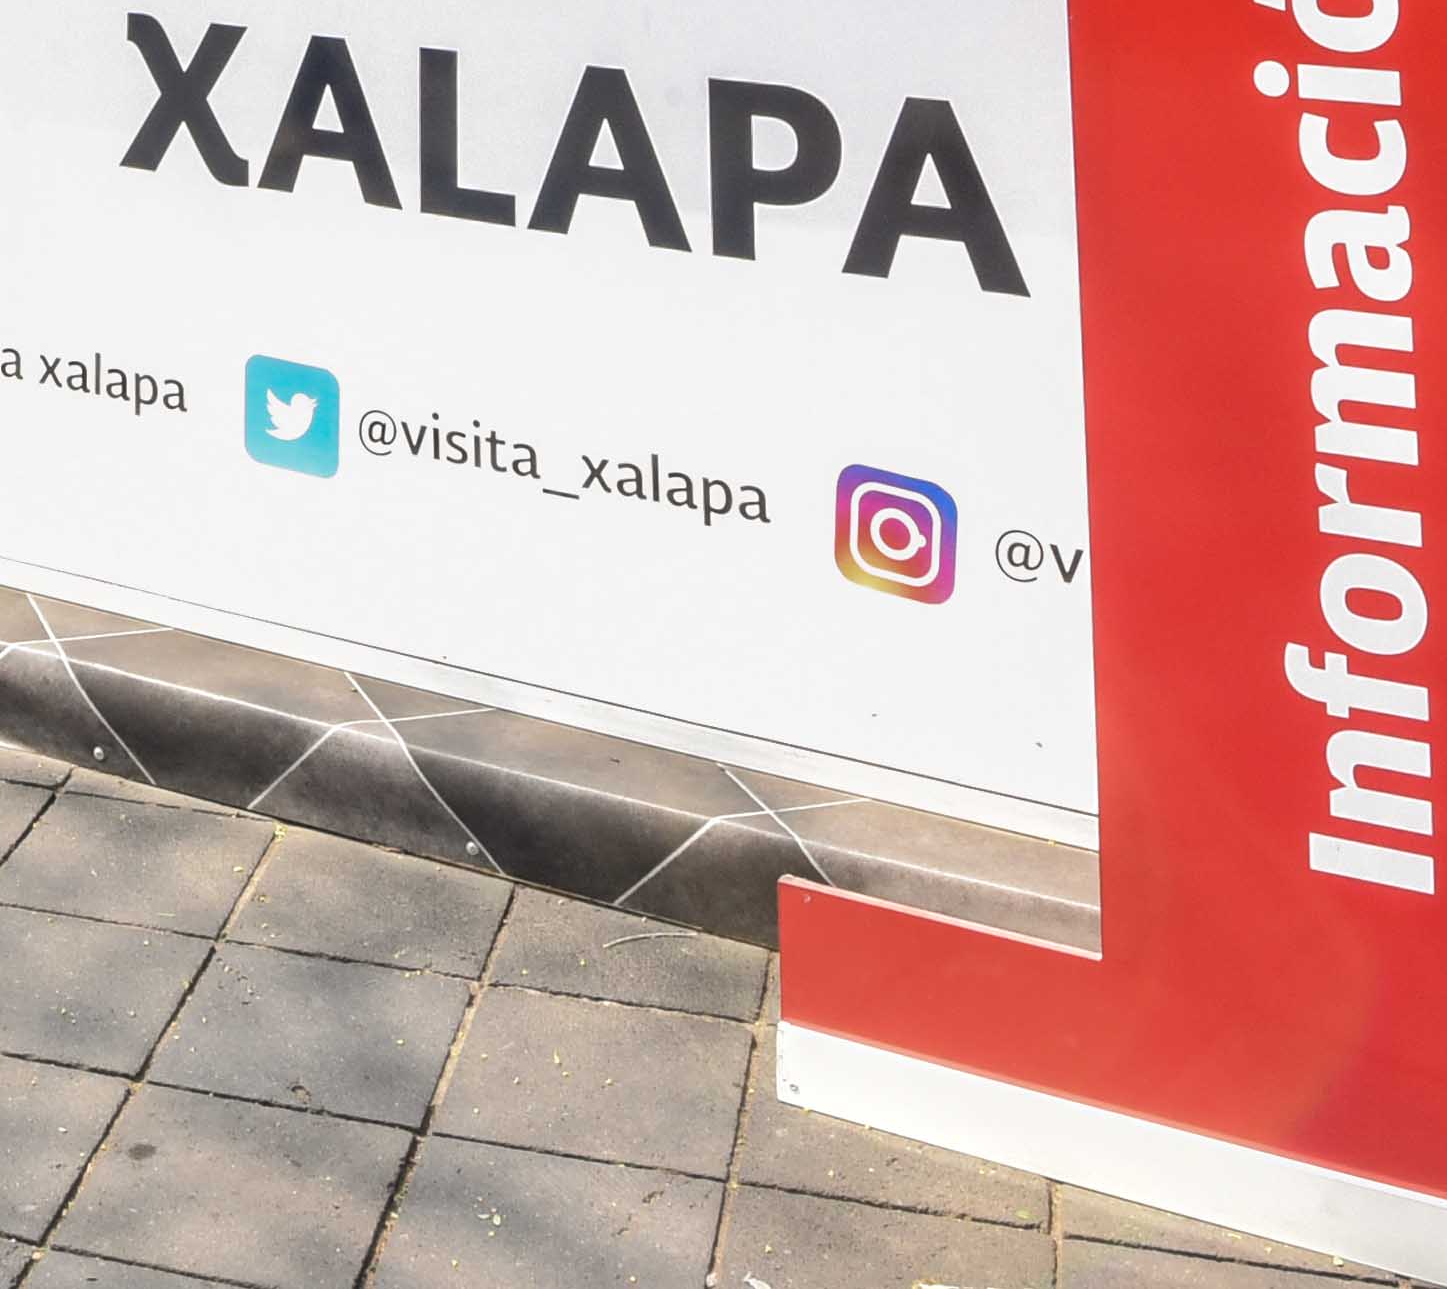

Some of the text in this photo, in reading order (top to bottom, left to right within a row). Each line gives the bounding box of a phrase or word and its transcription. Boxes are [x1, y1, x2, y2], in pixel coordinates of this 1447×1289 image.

[120, 12, 1031, 298] XALAPA
[39, 352, 188, 416] xalapa
[358, 409, 771, 527] @visita_xalapa
